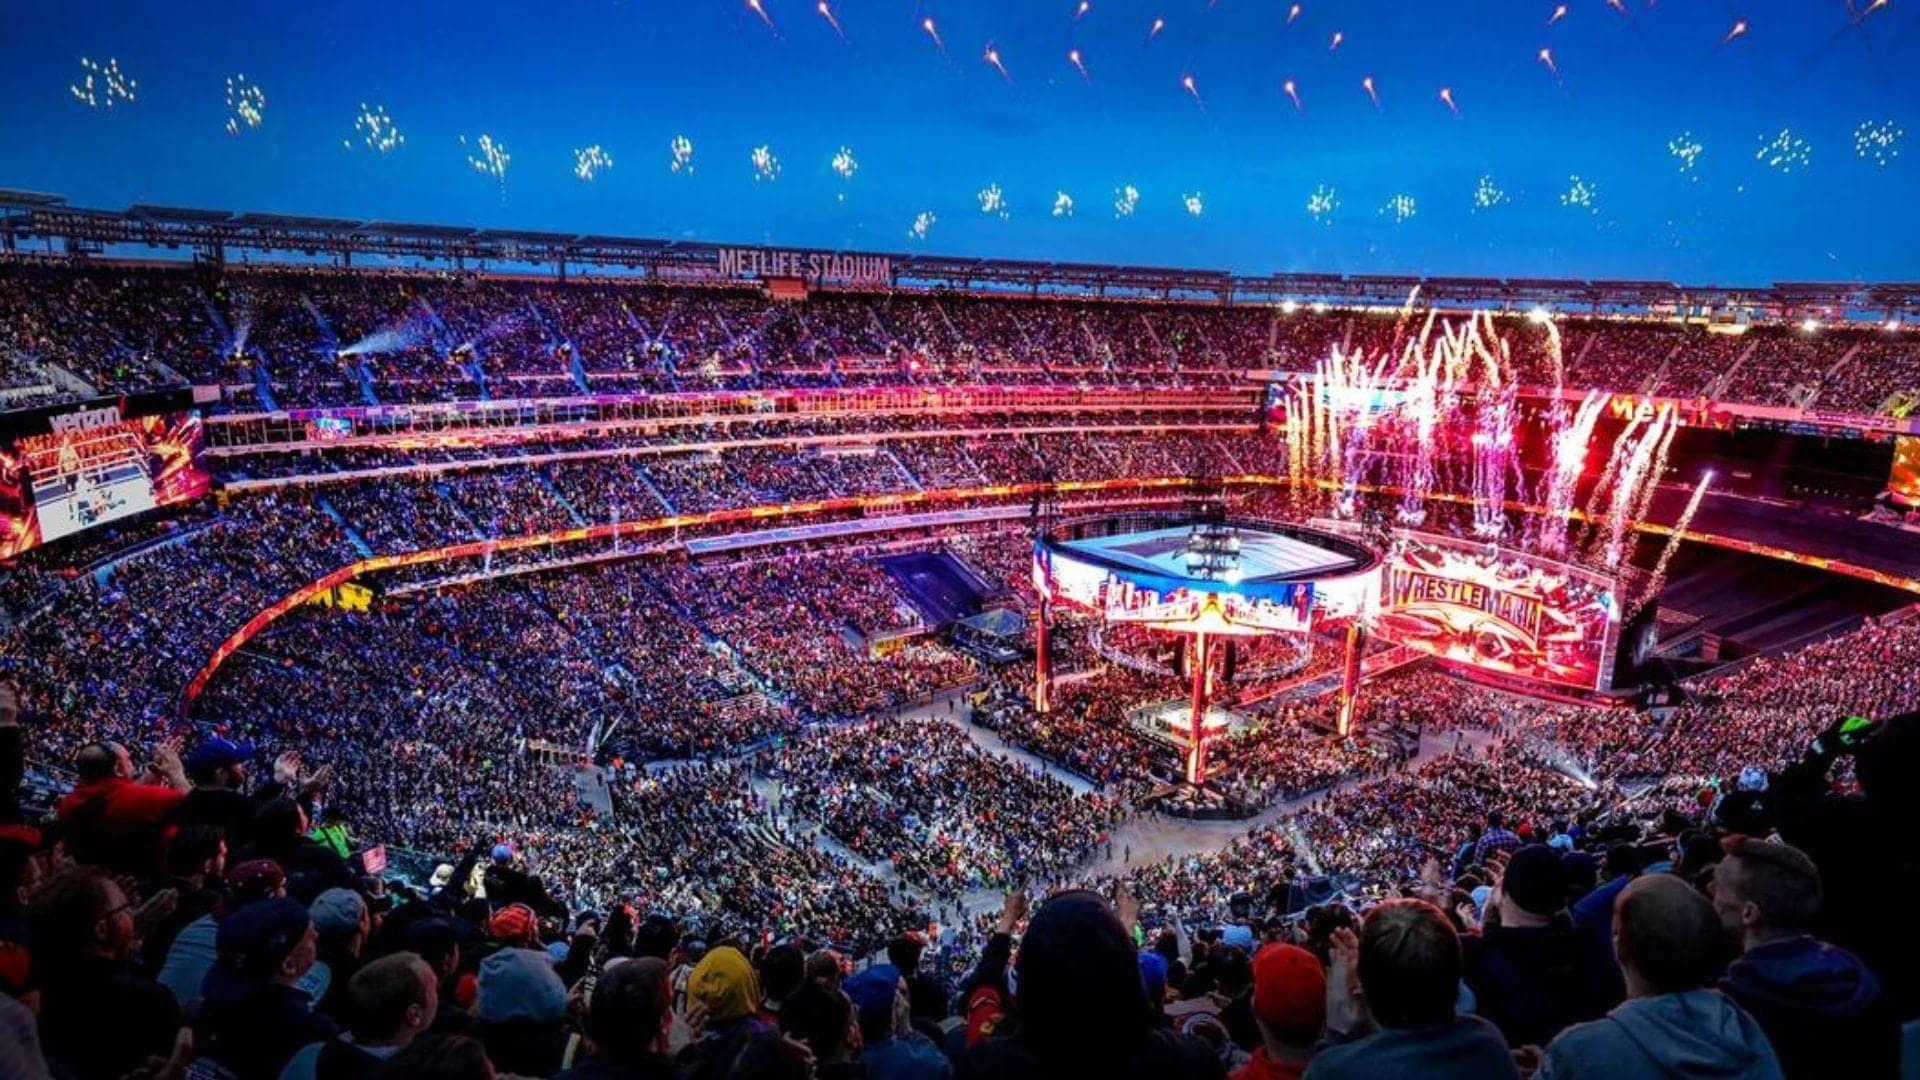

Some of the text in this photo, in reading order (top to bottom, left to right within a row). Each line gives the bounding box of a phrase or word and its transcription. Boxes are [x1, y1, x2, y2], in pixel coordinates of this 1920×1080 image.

[718, 248, 891, 282] METLIFE STADIUM
[48, 405, 120, 434] verizon
